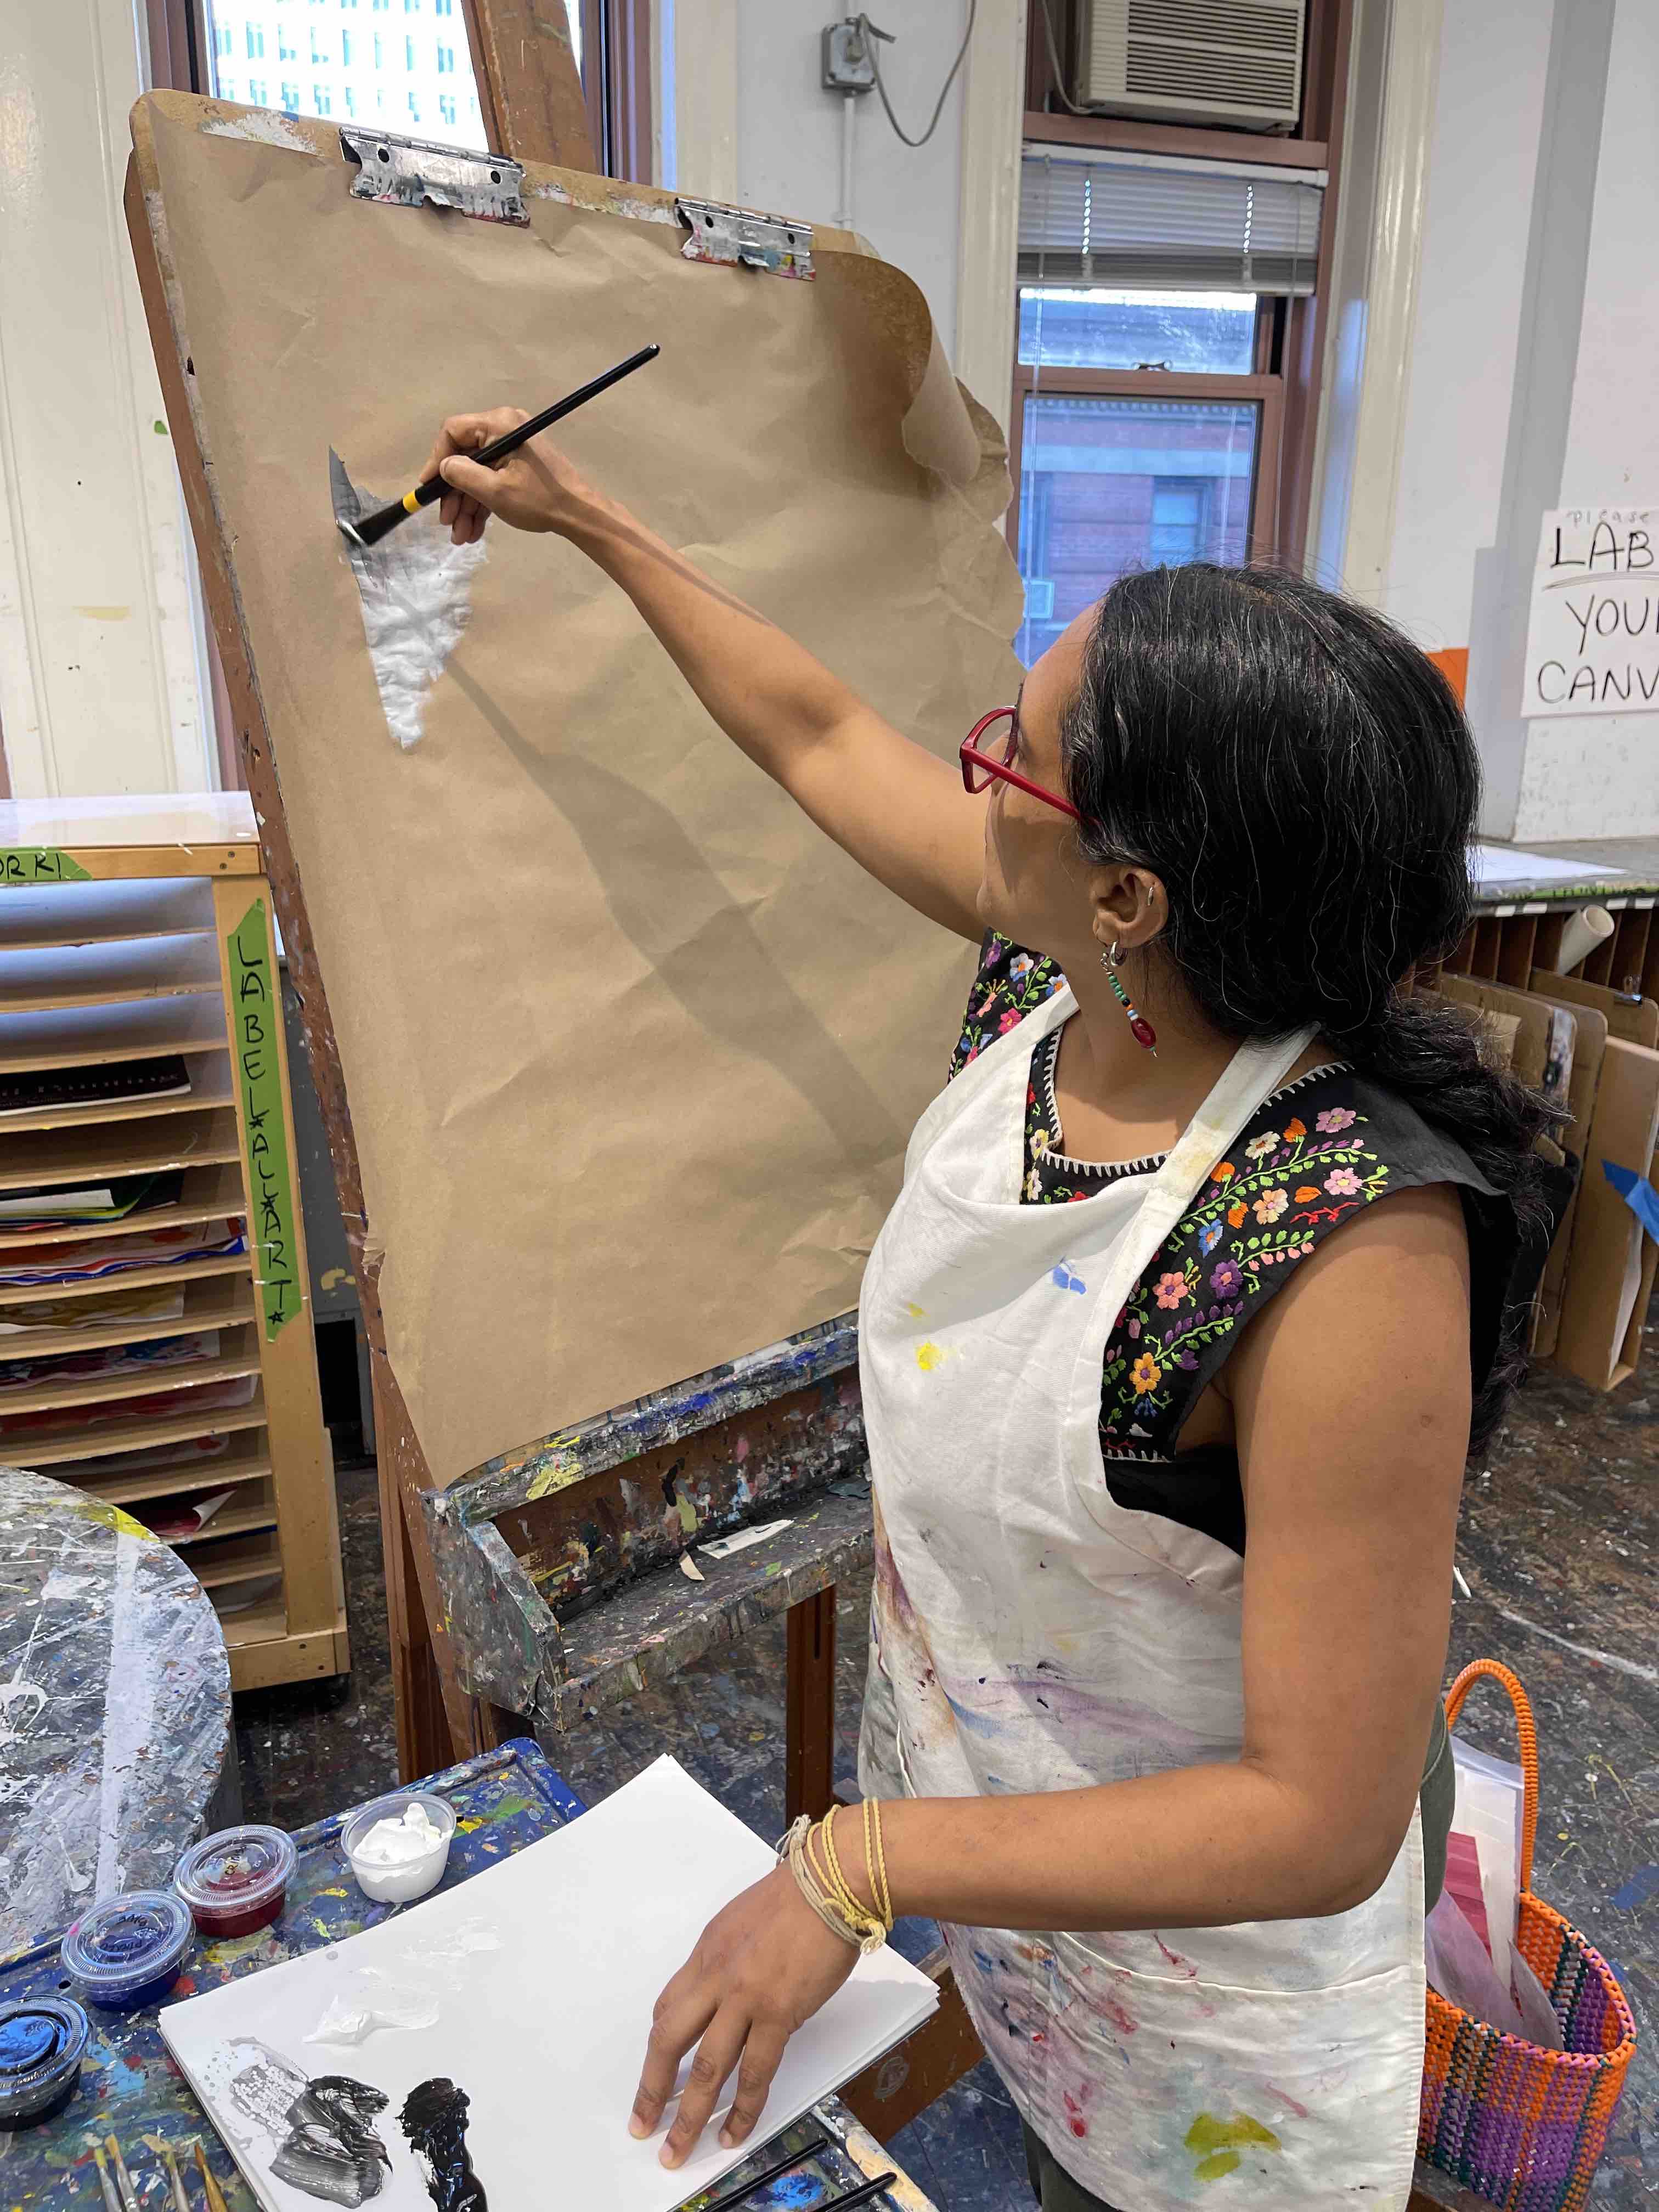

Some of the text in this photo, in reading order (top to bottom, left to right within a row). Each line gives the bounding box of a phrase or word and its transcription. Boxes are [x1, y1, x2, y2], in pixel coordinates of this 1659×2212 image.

[1550, 522, 1654, 572] LAB
[1565, 594, 1659, 655] YOU
[237, 935, 292, 1310] LABEL ALL ART
